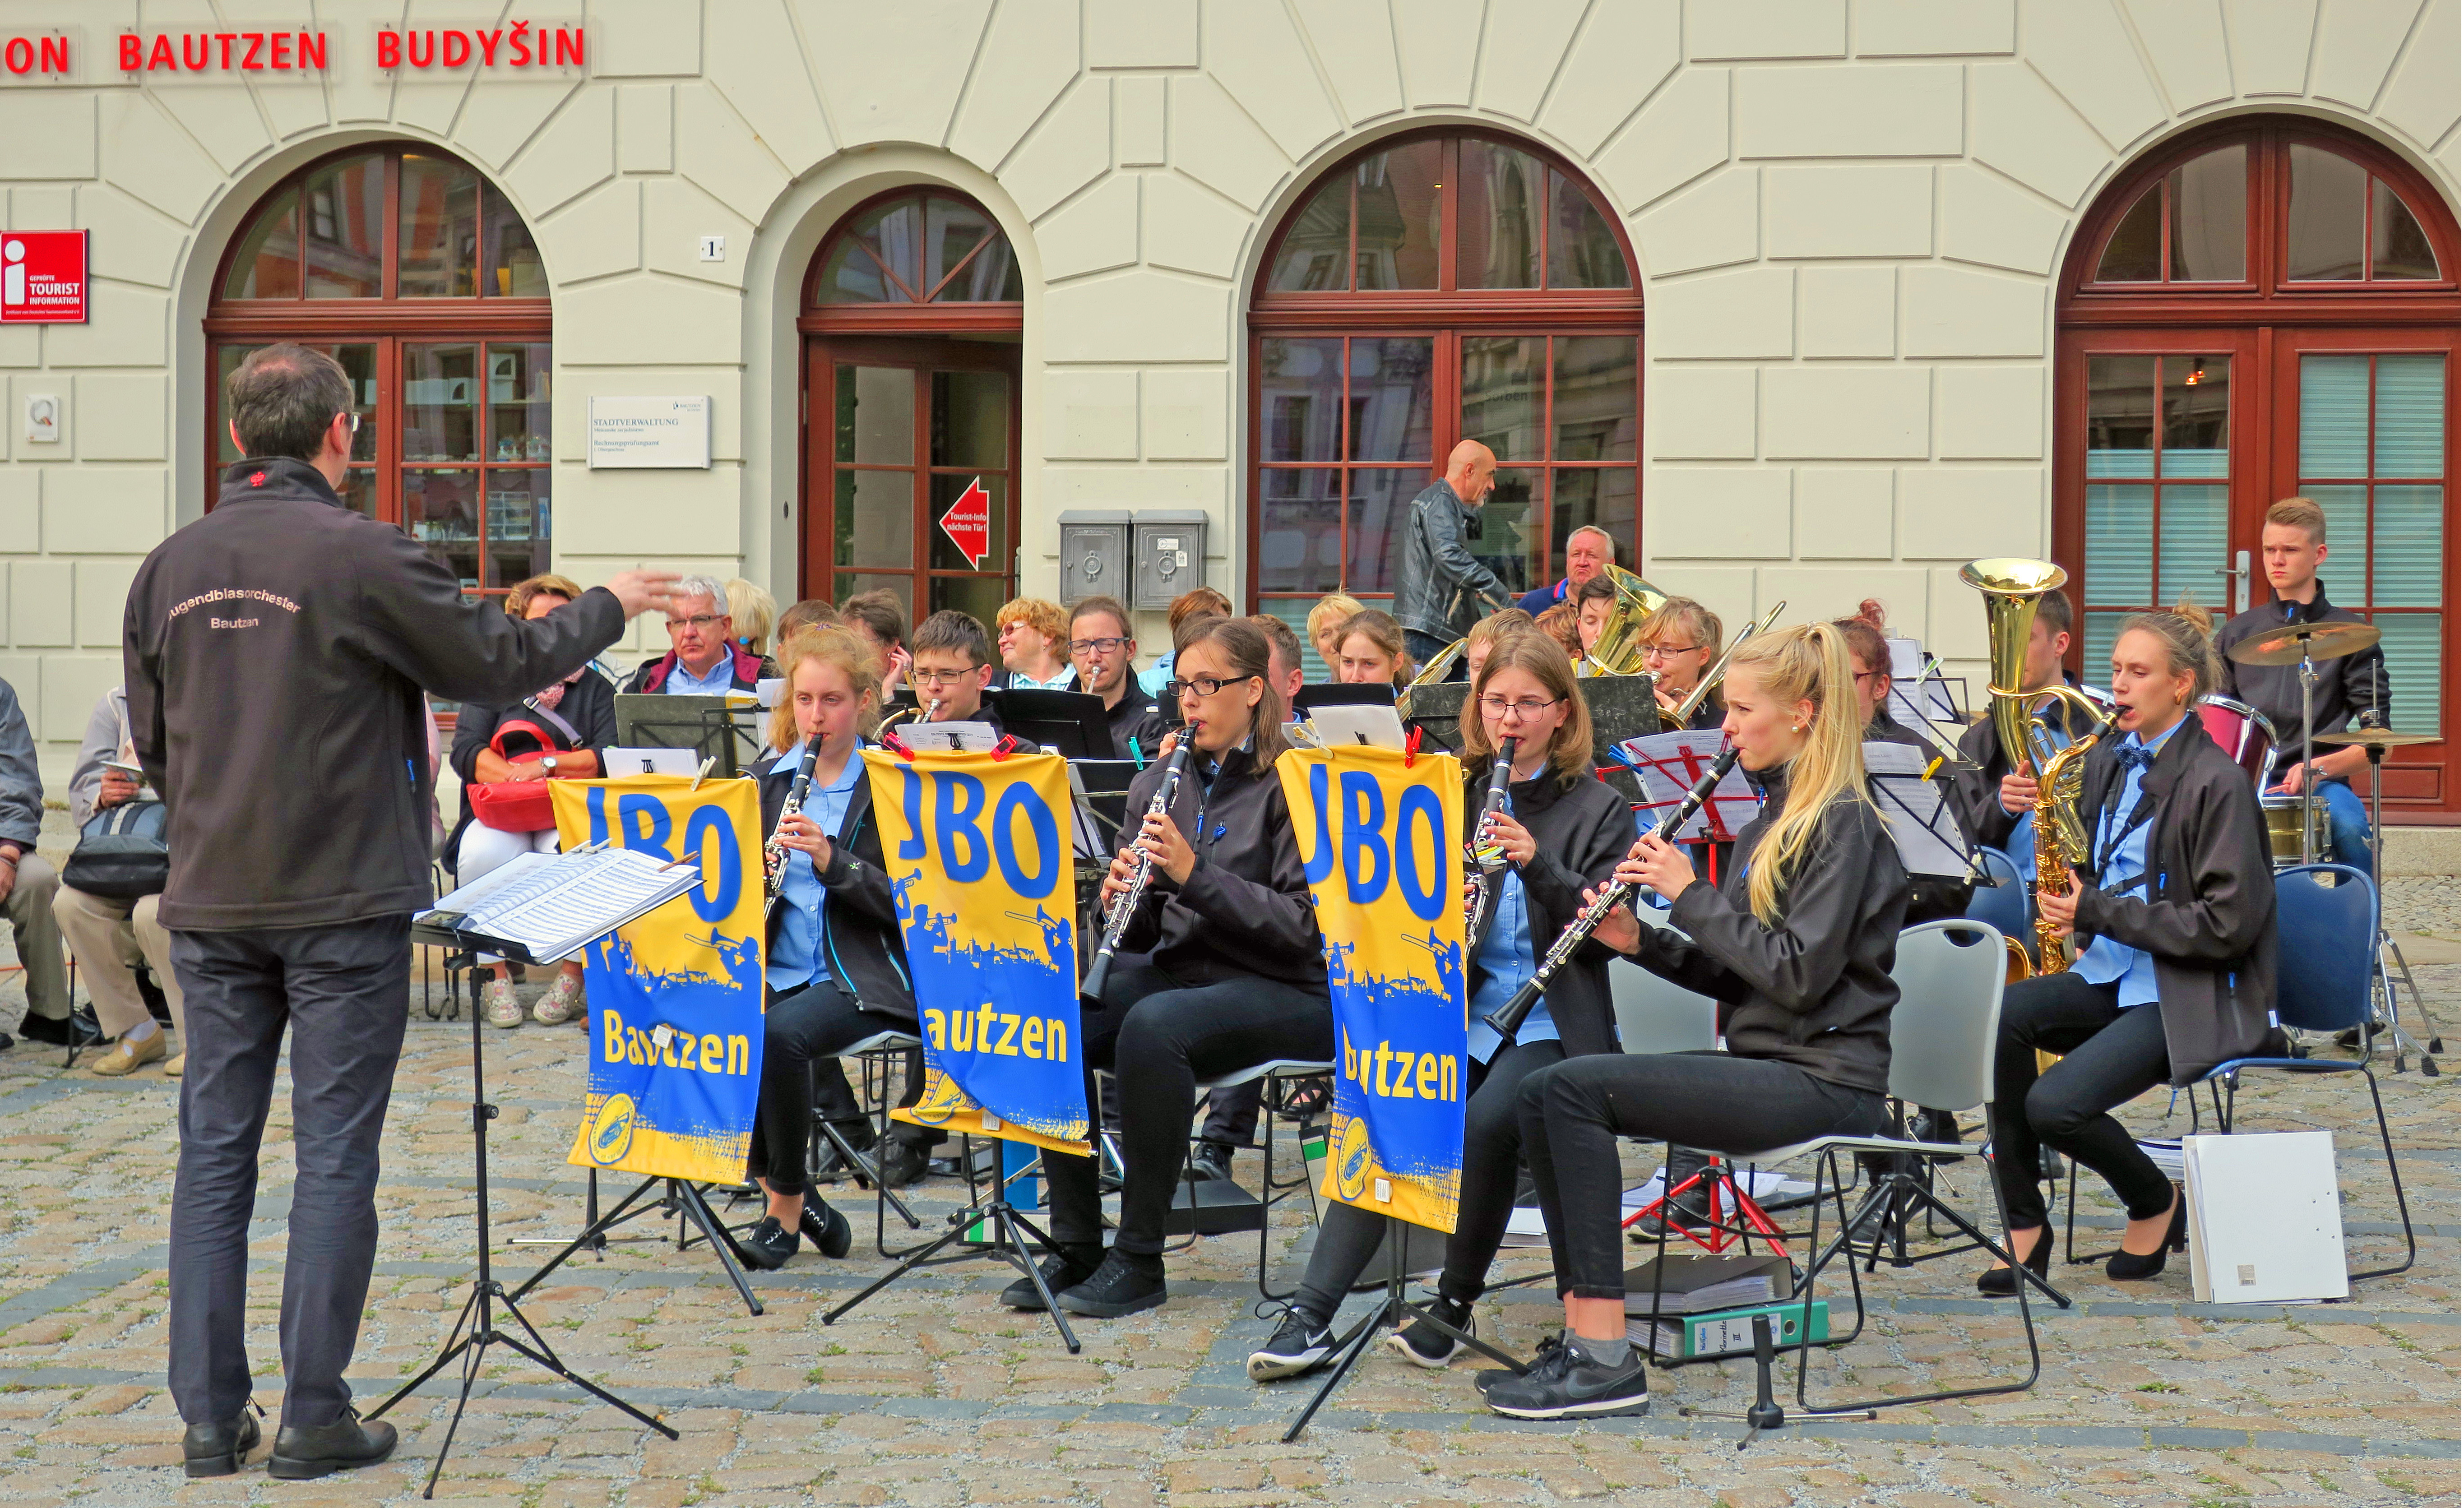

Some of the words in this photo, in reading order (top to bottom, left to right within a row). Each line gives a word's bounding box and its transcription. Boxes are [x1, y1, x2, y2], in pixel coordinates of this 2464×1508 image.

[4, 36, 68, 74] ON
[119, 32, 327, 71] BAUTZEN
[377, 20, 585, 68] BUDYŠIN
[708, 241, 714, 256] 1
[29, 274, 55, 282] GEPRÜFTE
[29, 282, 80, 296] TOURIST
[29, 297, 79, 305] INFORMATION
[950, 512, 986, 521] Tourist-Info
[947, 523, 972, 531] nächste
[973, 523, 986, 532] Tür!
[210, 617, 259, 629] Bautzen
[894, 763, 1060, 899] JBO
[1302, 763, 1446, 921] JBO
